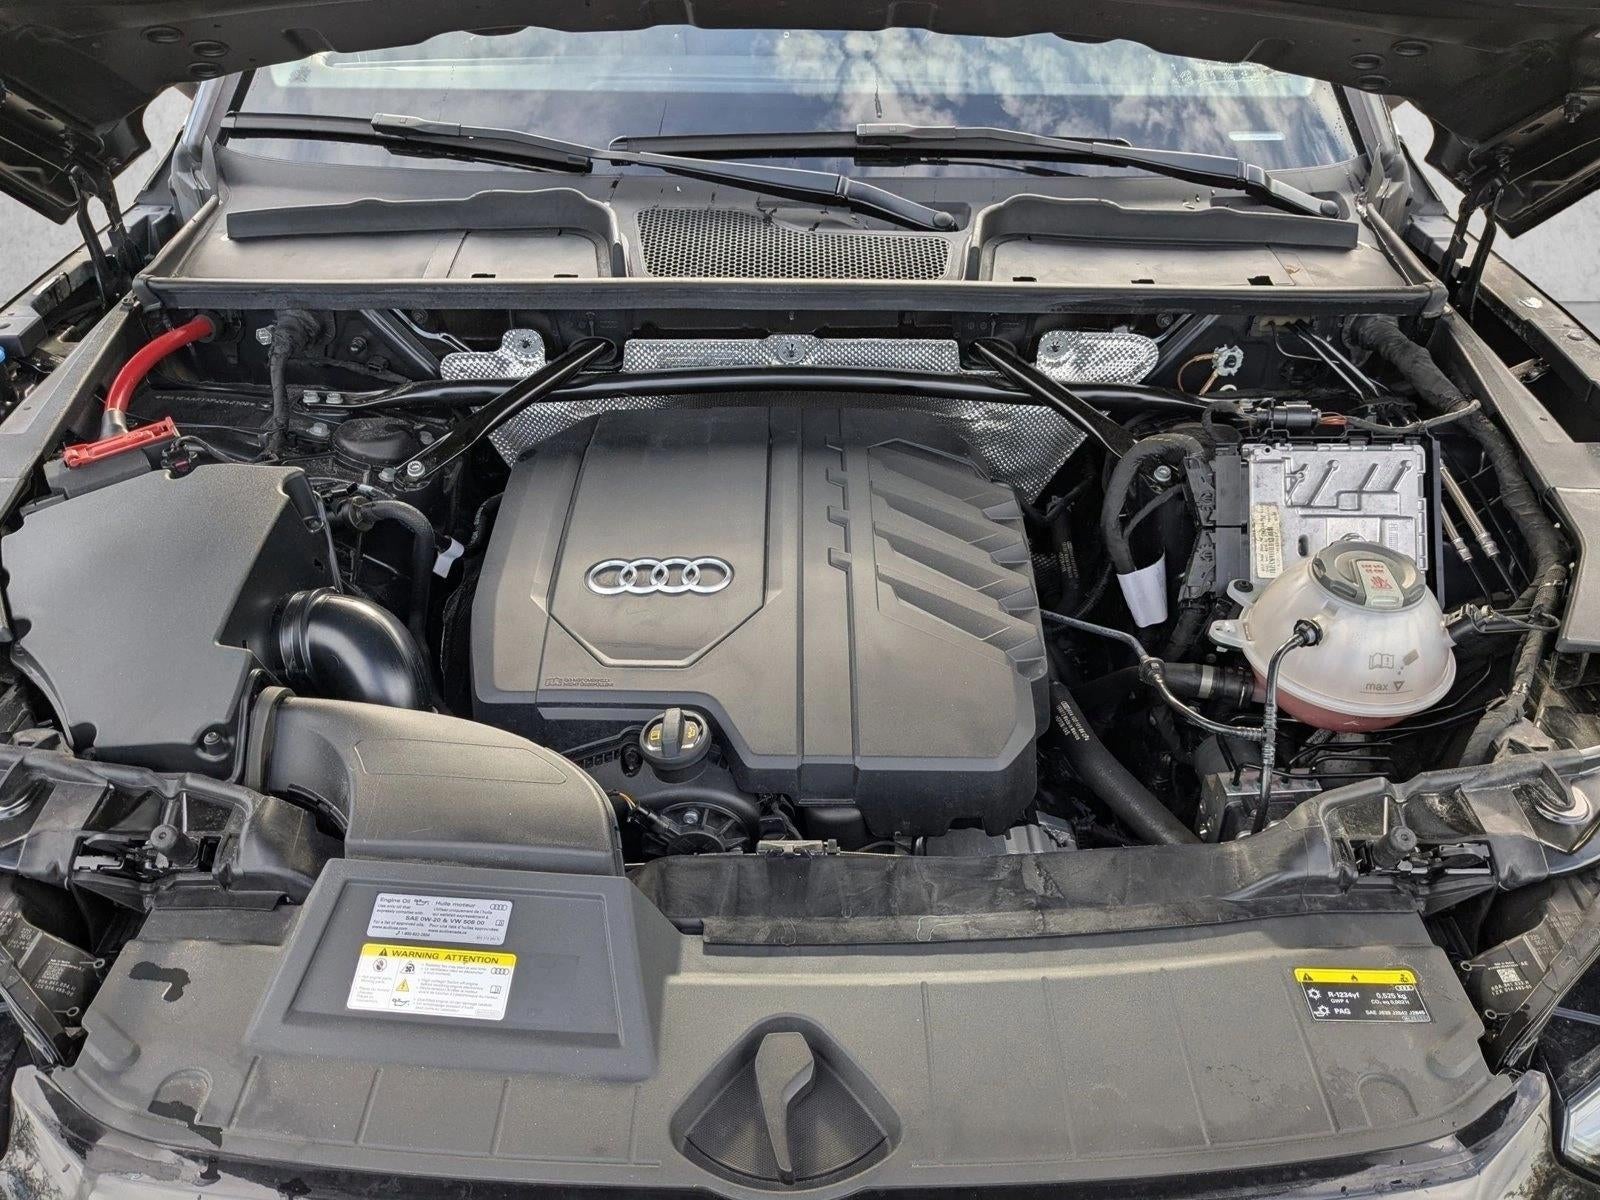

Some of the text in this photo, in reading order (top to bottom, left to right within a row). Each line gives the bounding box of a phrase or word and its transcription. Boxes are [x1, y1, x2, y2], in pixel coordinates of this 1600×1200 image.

[1366, 683, 1388, 691] max
[391, 949, 499, 964] WARNING ATTENTION
[1327, 991, 1360, 999] R-1234yf
